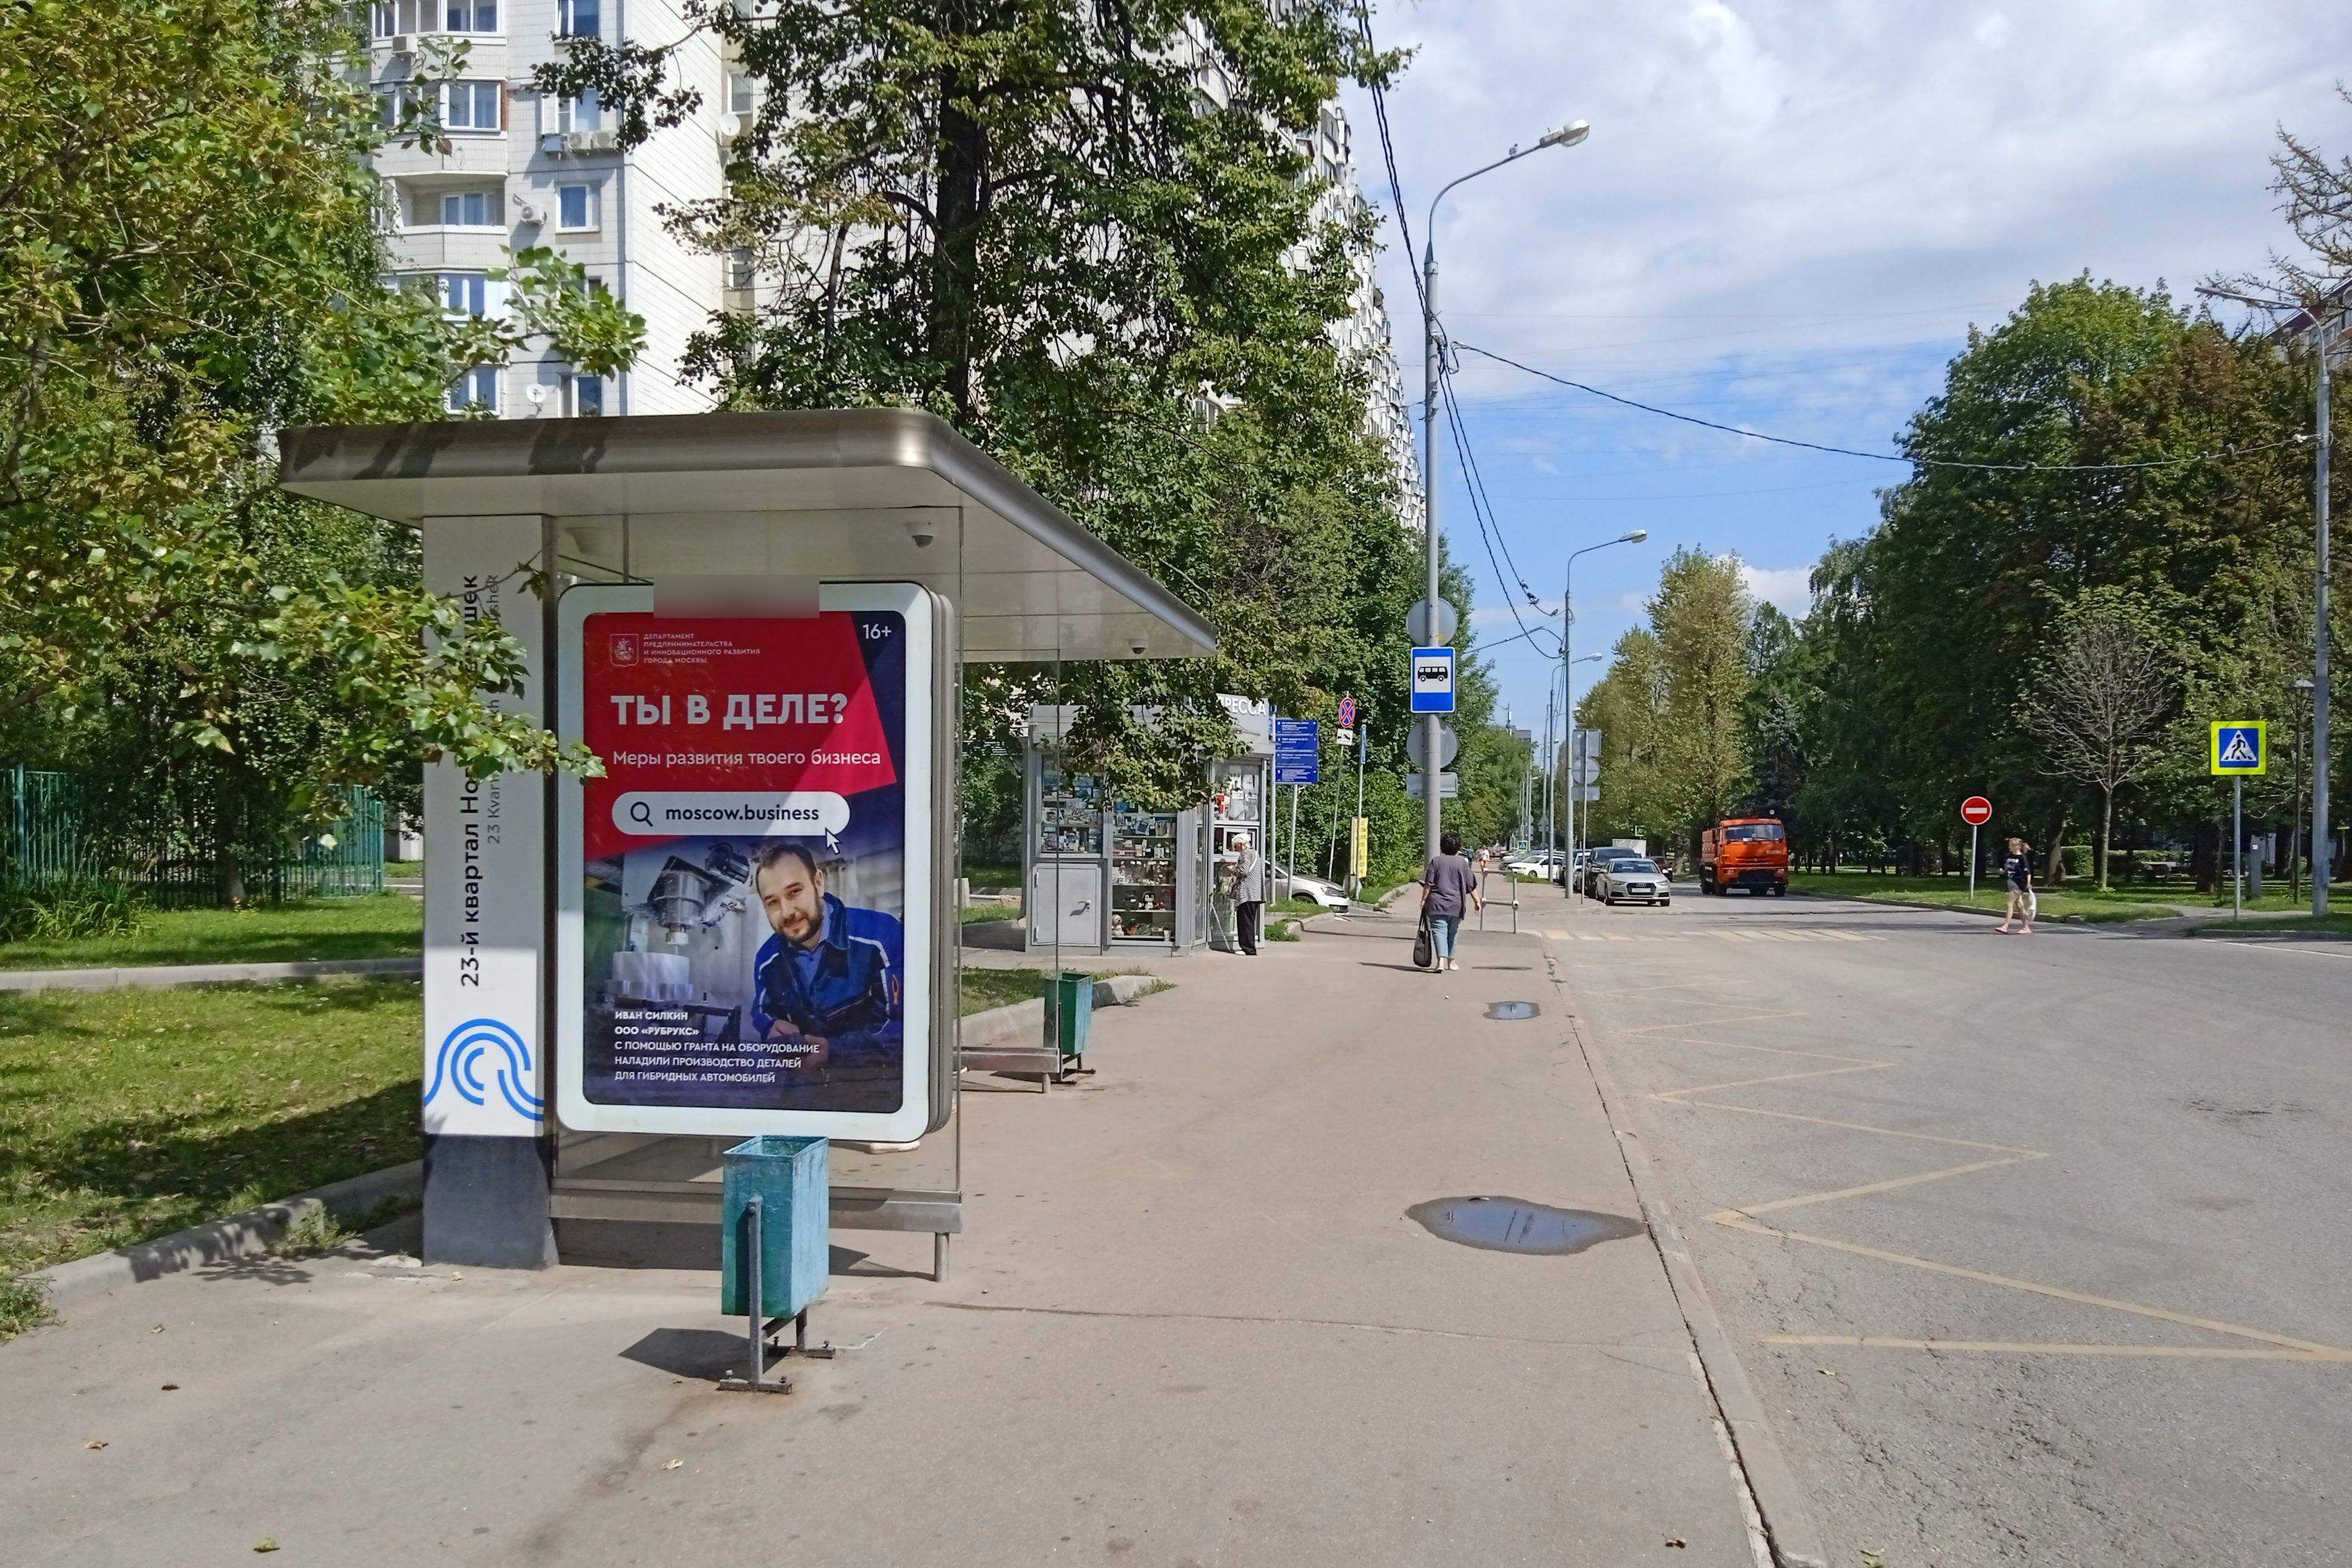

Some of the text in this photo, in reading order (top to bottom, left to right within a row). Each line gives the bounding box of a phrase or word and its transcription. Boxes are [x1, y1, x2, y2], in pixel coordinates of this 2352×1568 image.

[862, 623, 892, 639] 16+
[611, 693, 847, 730] ТЫ В ДЕЛЕ?
[613, 749, 880, 767] Меры развития твоего бизнеса
[666, 804, 819, 820] moscow.business
[487, 824, 500, 844] 23
[464, 823, 483, 923] квартал
[461, 932, 479, 988] 23-й
[614, 1011, 688, 1021] ИВАН СИЛКИН
[614, 1026, 700, 1036] ООО «РУБРУКС»
[614, 1041, 820, 1054] С ПОМОЩЬЮ ГРАНТА НА ОБОРУДОВАНИЕ
[614, 1056, 802, 1069] НАЛАДИЛИ ПРОИЗВОДСТВО ДЕТАЛЕЙ
[614, 1071, 776, 1083] ДЛЯ ГИБРИДНЫХ АВТОМОБИЛЕЙ
